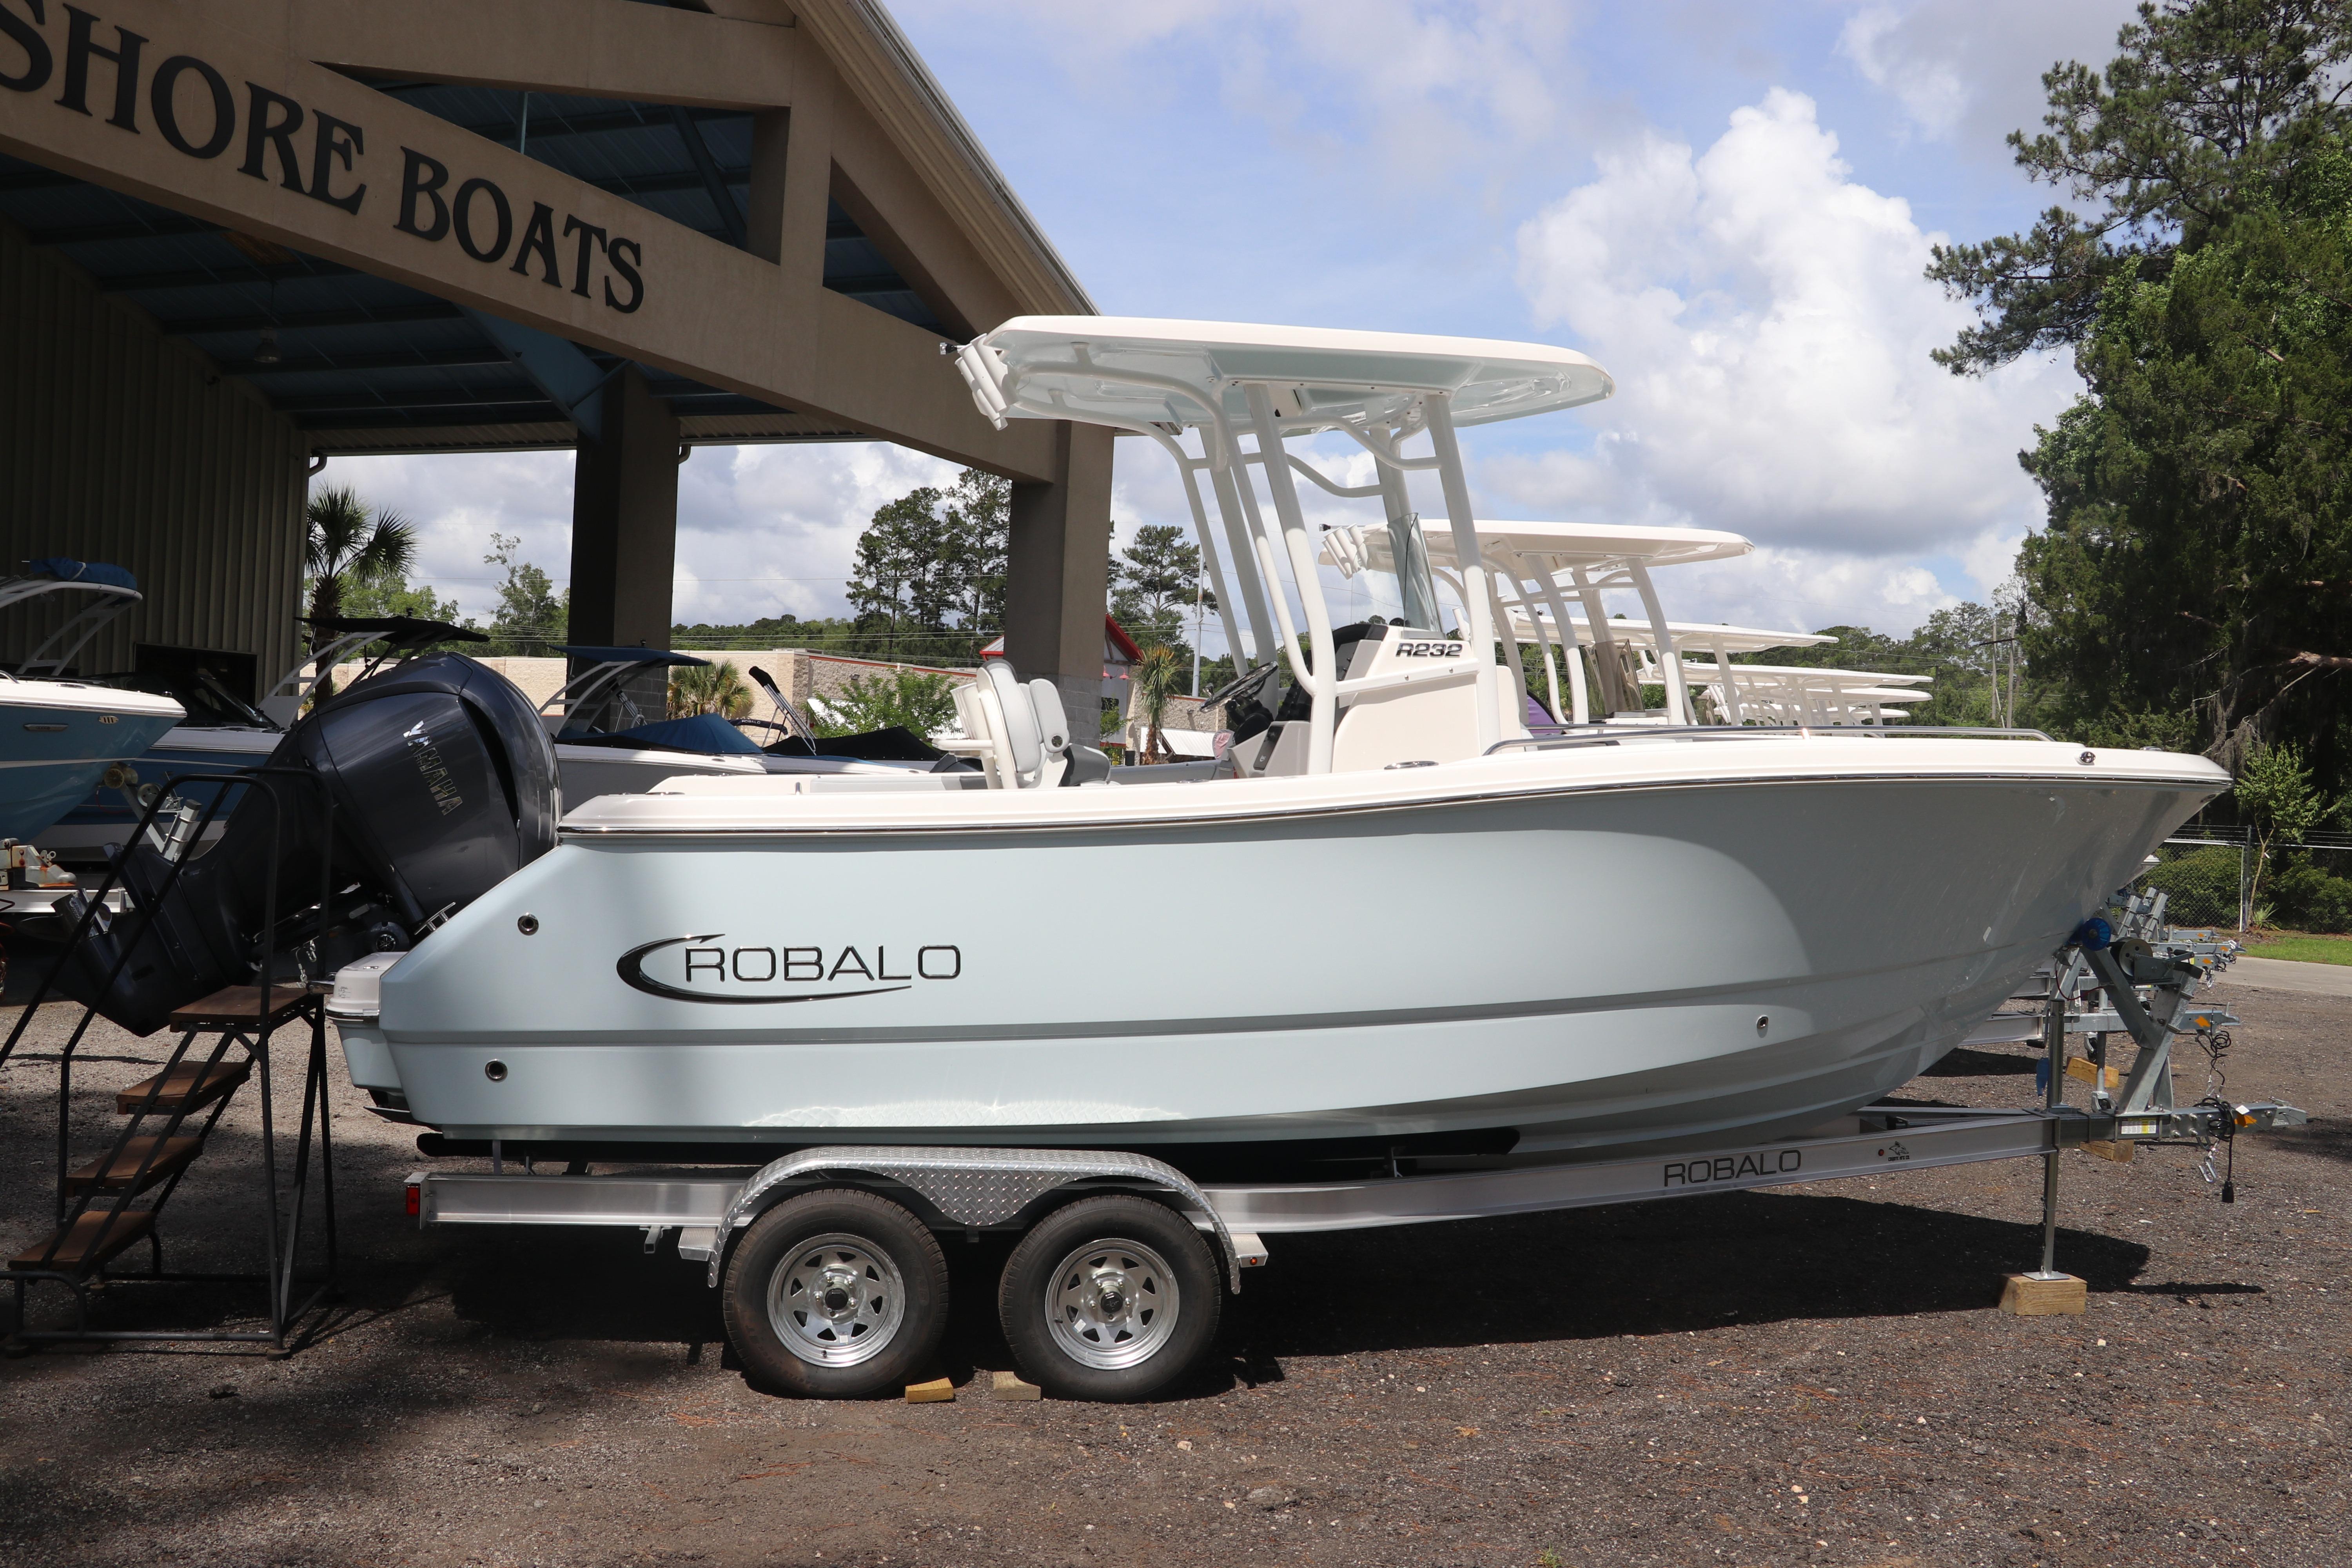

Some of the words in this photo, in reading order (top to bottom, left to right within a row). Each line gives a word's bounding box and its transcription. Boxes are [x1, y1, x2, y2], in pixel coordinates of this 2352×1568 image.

[393, 146, 644, 314] BOATS
[1396, 643, 1463, 658] R232
[403, 720, 463, 816] YAMAHA
[685, 944, 961, 982] ROBALO
[1664, 1150, 1801, 1187] ROBALO
